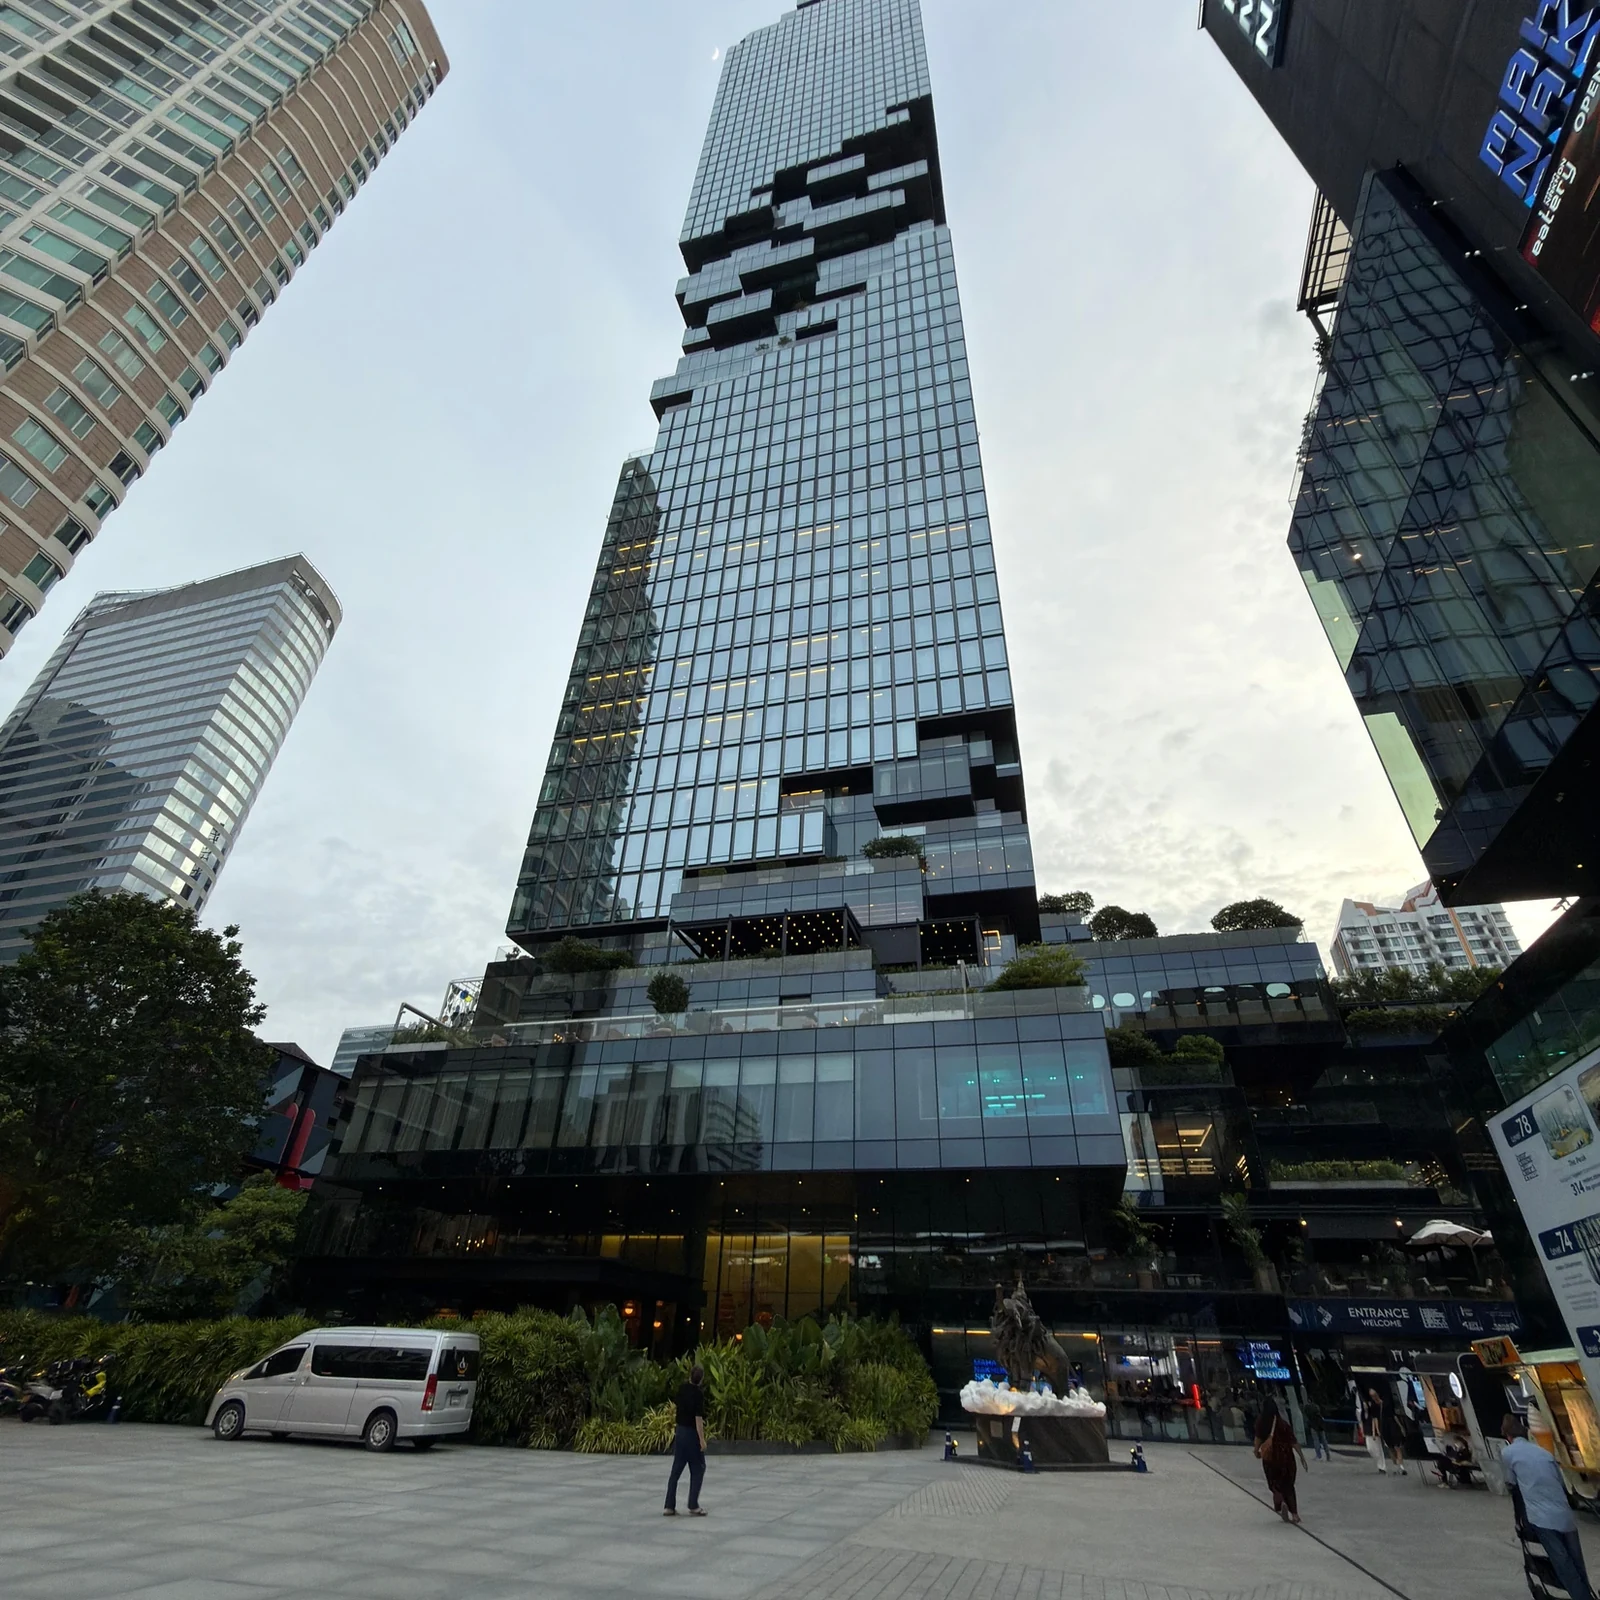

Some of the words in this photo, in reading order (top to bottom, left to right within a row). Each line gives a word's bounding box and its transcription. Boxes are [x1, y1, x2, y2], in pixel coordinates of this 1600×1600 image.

[1532, 161, 1577, 256] eatery
[1516, 1114, 1532, 1137] 78
[1570, 1180, 1586, 1196] 314
[1555, 1229, 1574, 1252] 74
[1347, 1307, 1410, 1319] ENTRANCE
[1361, 1319, 1402, 1327] WELCOME
[1250, 1342, 1270, 1350] KING
[1252, 1351, 1281, 1360] POWER
